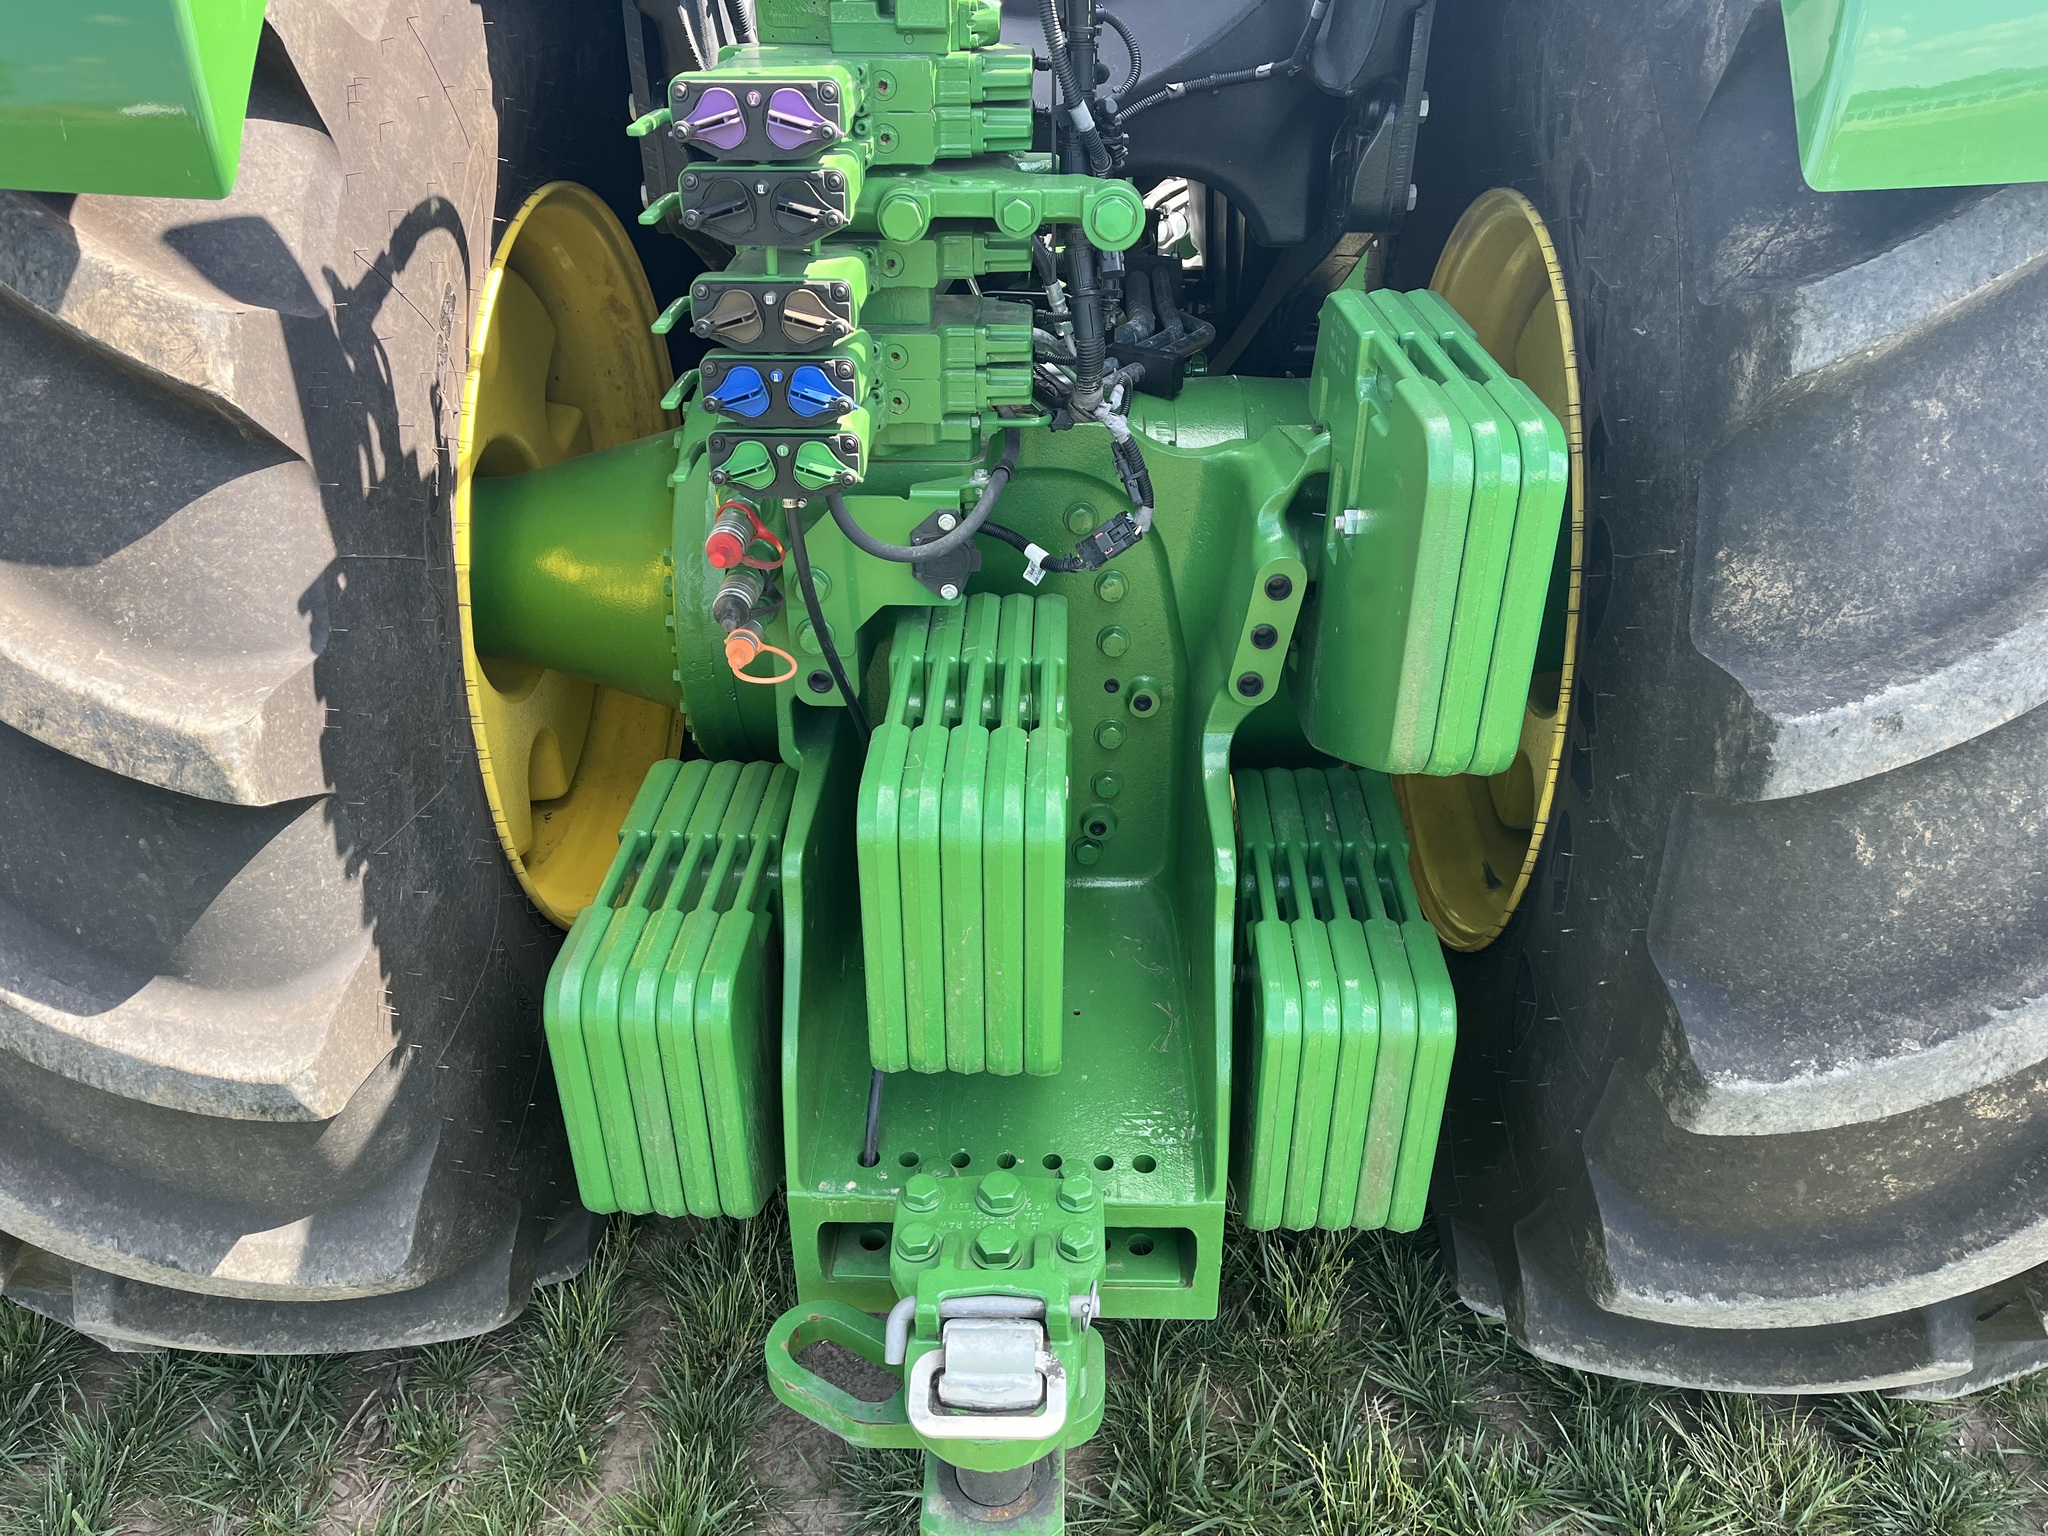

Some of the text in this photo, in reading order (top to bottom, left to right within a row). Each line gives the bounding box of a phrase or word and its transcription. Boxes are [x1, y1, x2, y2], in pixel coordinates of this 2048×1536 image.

[748, 94, 757, 105] V
[765, 295, 773, 305] III
[1024, 1212, 1044, 1220] USA
